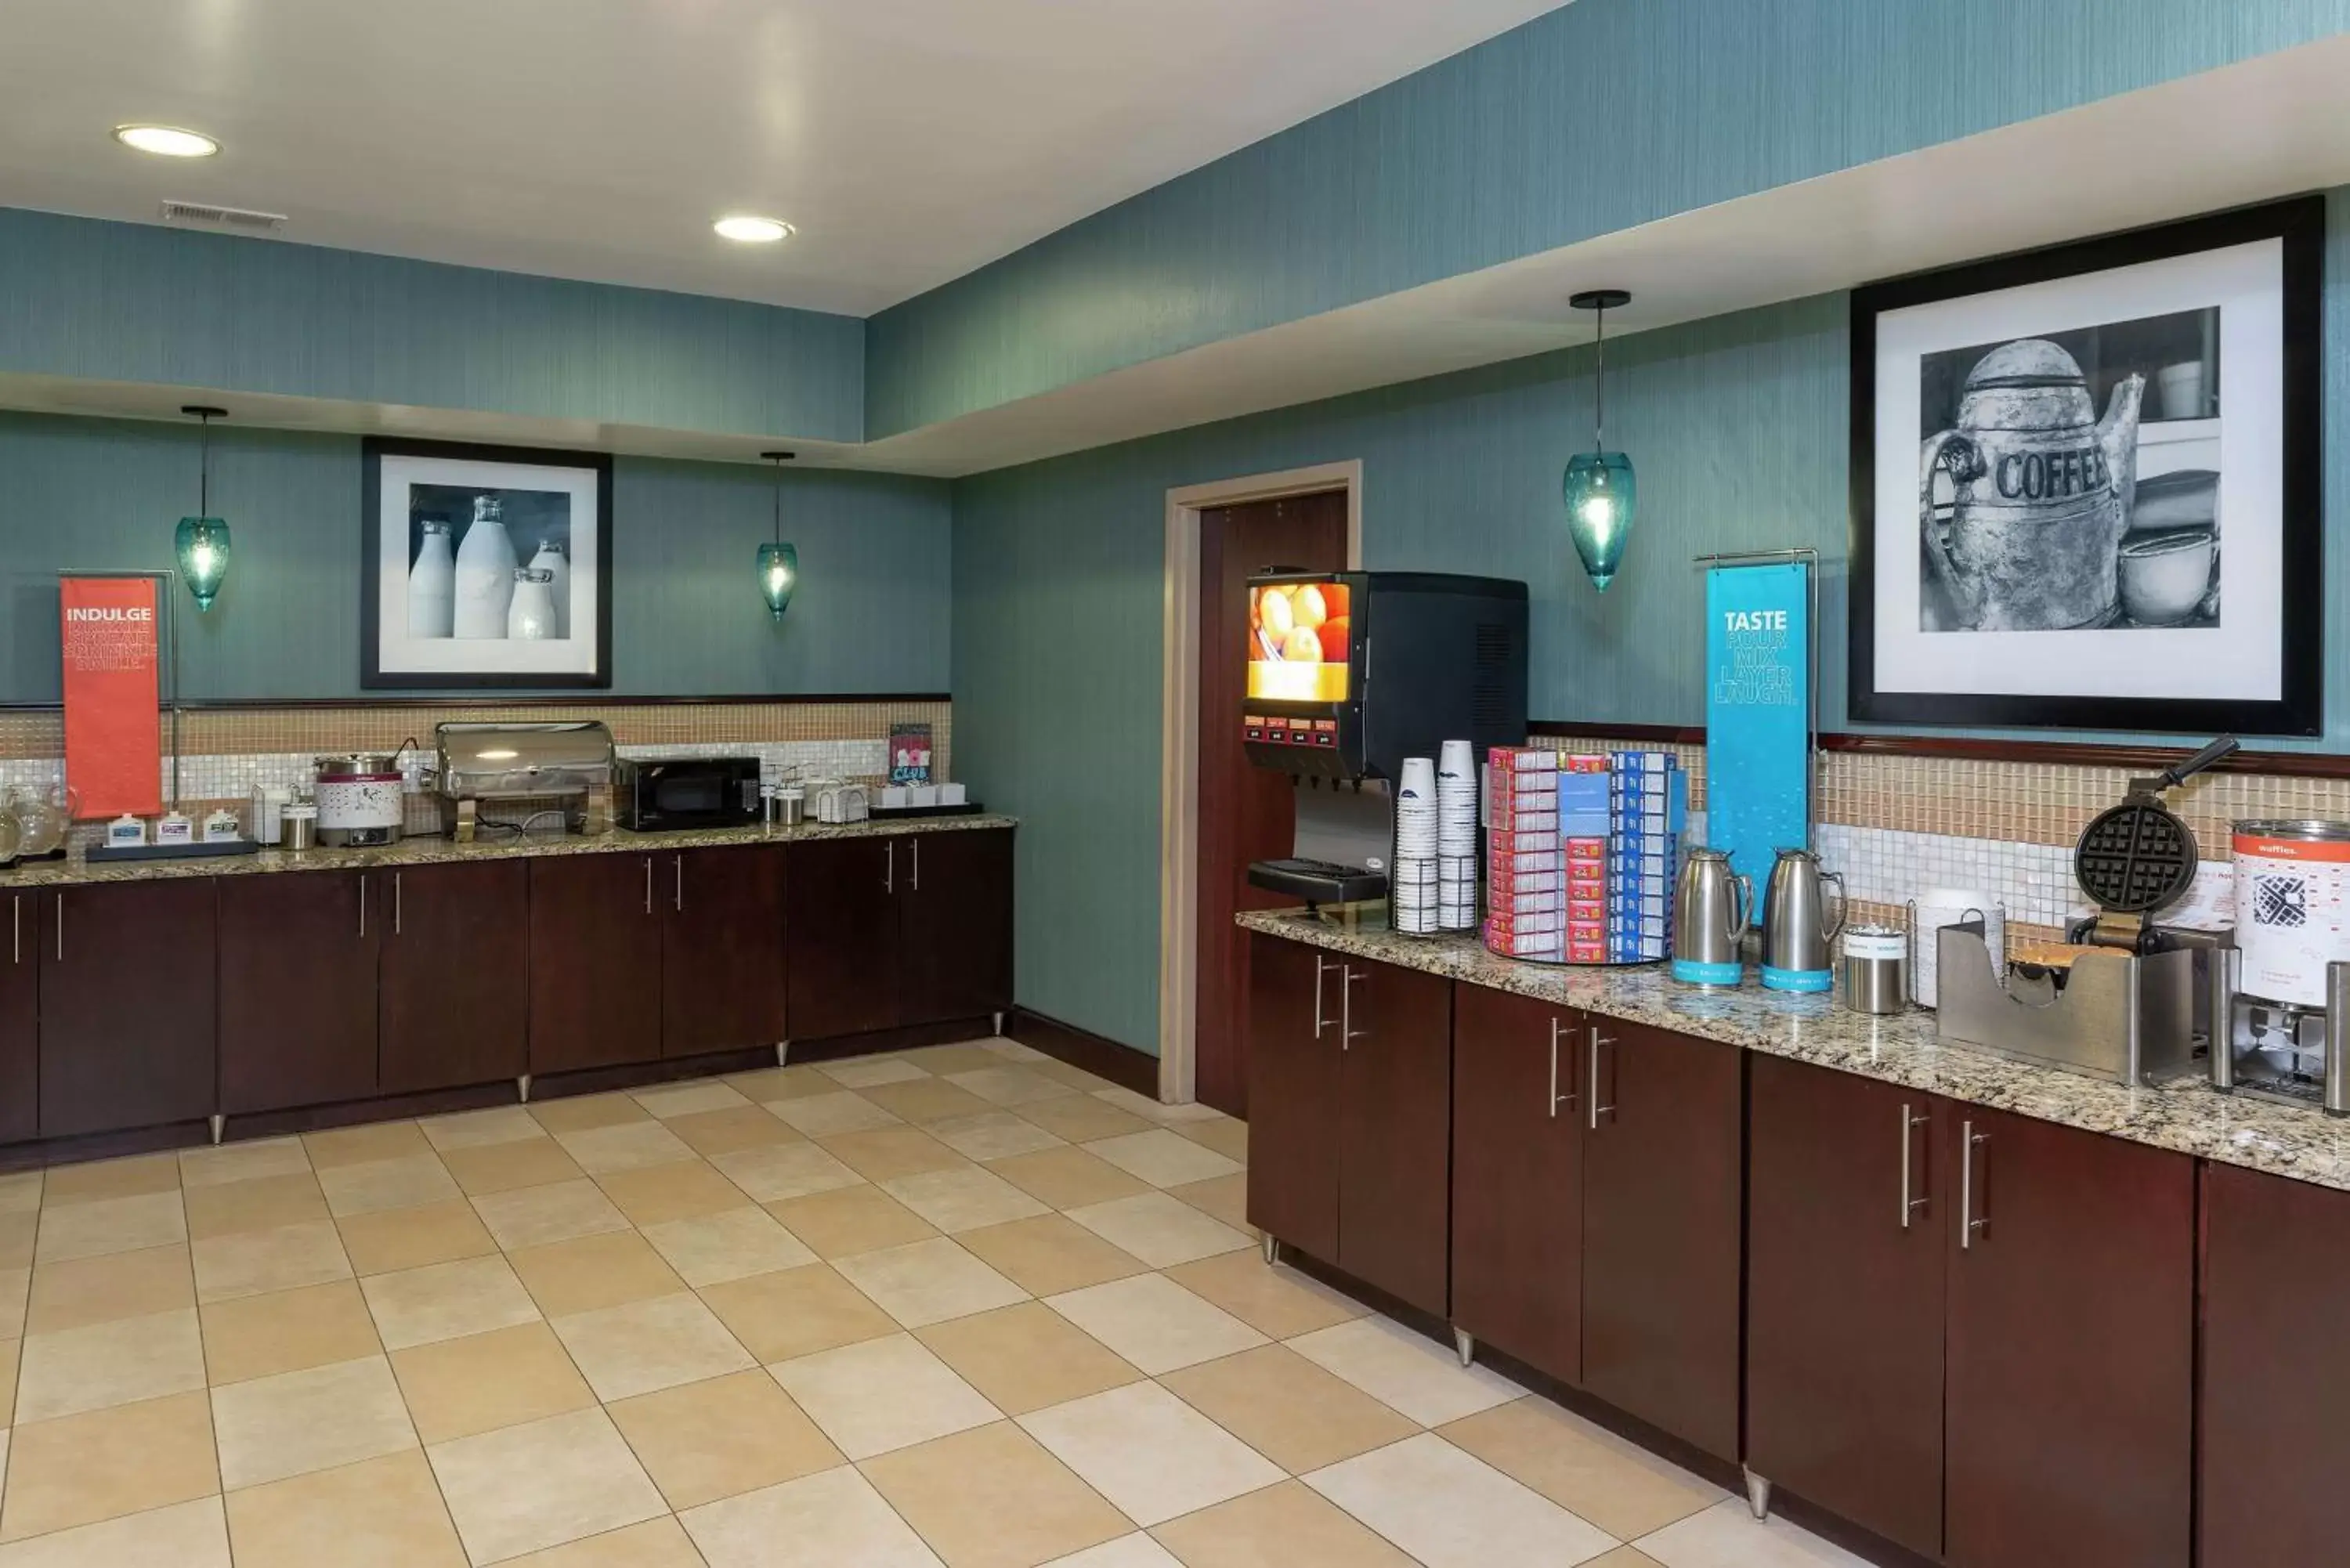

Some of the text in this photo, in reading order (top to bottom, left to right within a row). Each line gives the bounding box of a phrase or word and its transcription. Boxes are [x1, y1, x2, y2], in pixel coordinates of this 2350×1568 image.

[1997, 445, 2106, 499] COFFEE
[67, 608, 151, 621] INDULGE
[1725, 610, 1787, 630] TASTE
[70, 632, 150, 645] SPREAD
[1728, 630, 1787, 649] POUR
[1734, 647, 1777, 667] MIX
[1721, 666, 1792, 685] LAYER
